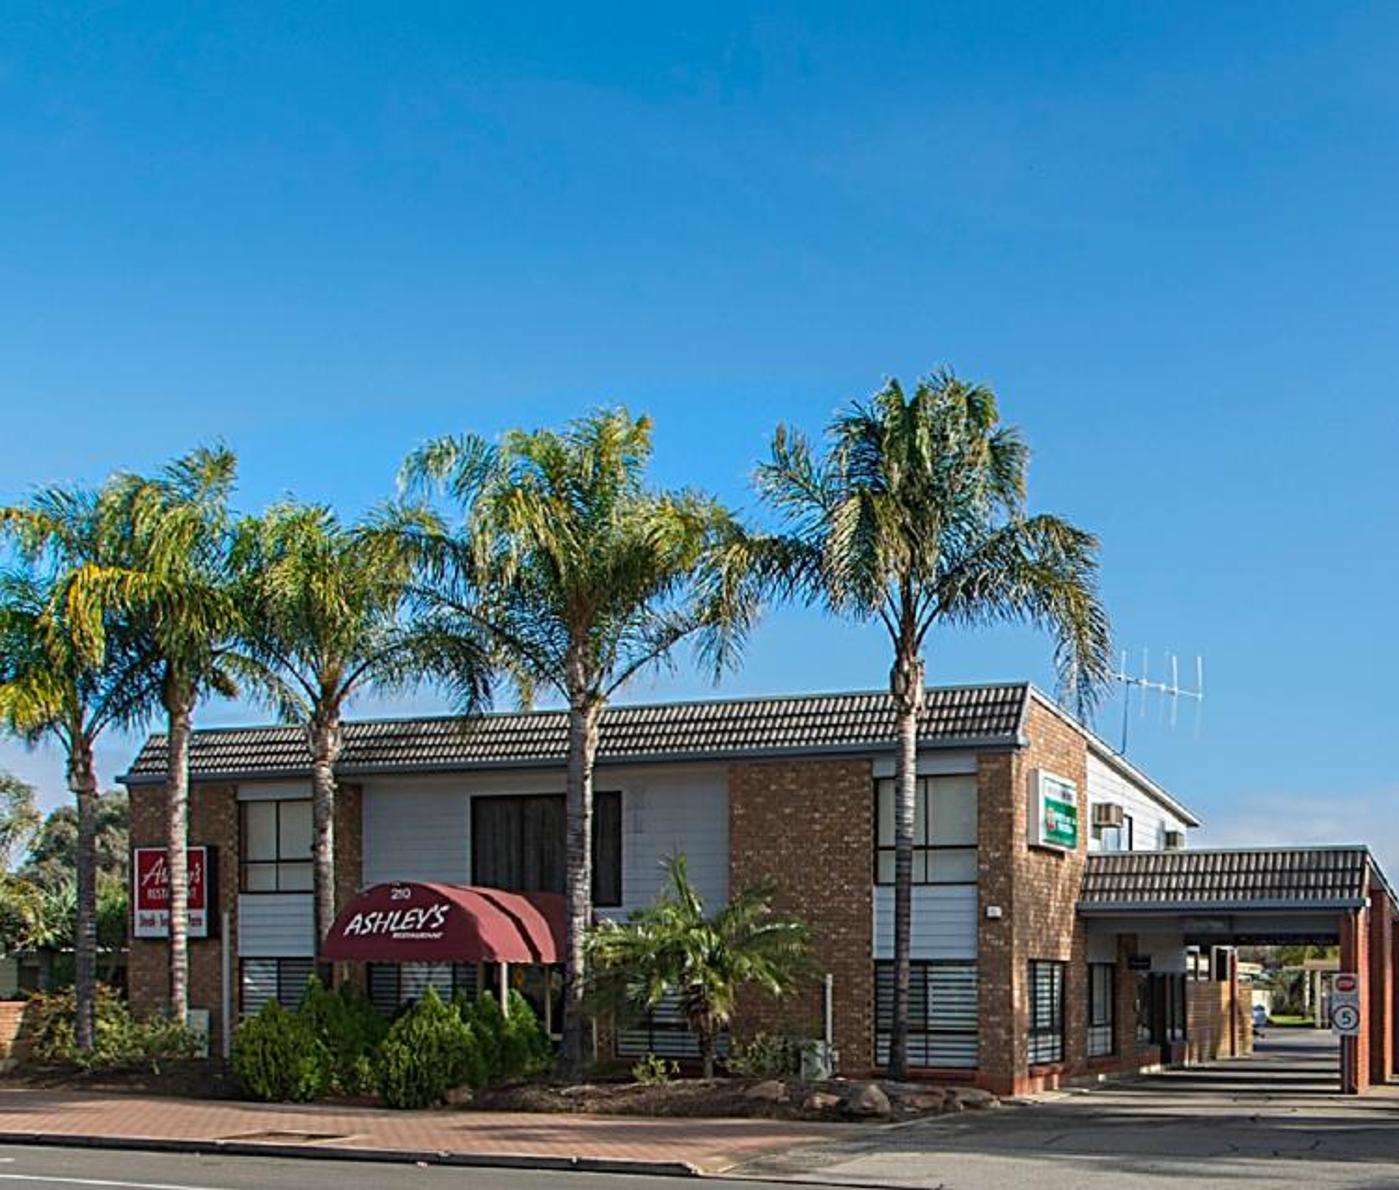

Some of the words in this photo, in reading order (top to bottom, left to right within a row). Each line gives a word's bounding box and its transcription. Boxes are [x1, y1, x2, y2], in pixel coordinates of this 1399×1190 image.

[391, 888, 411, 899] 210
[343, 904, 450, 937] ASHLEY'S
[1342, 1011, 1351, 1024] 5
